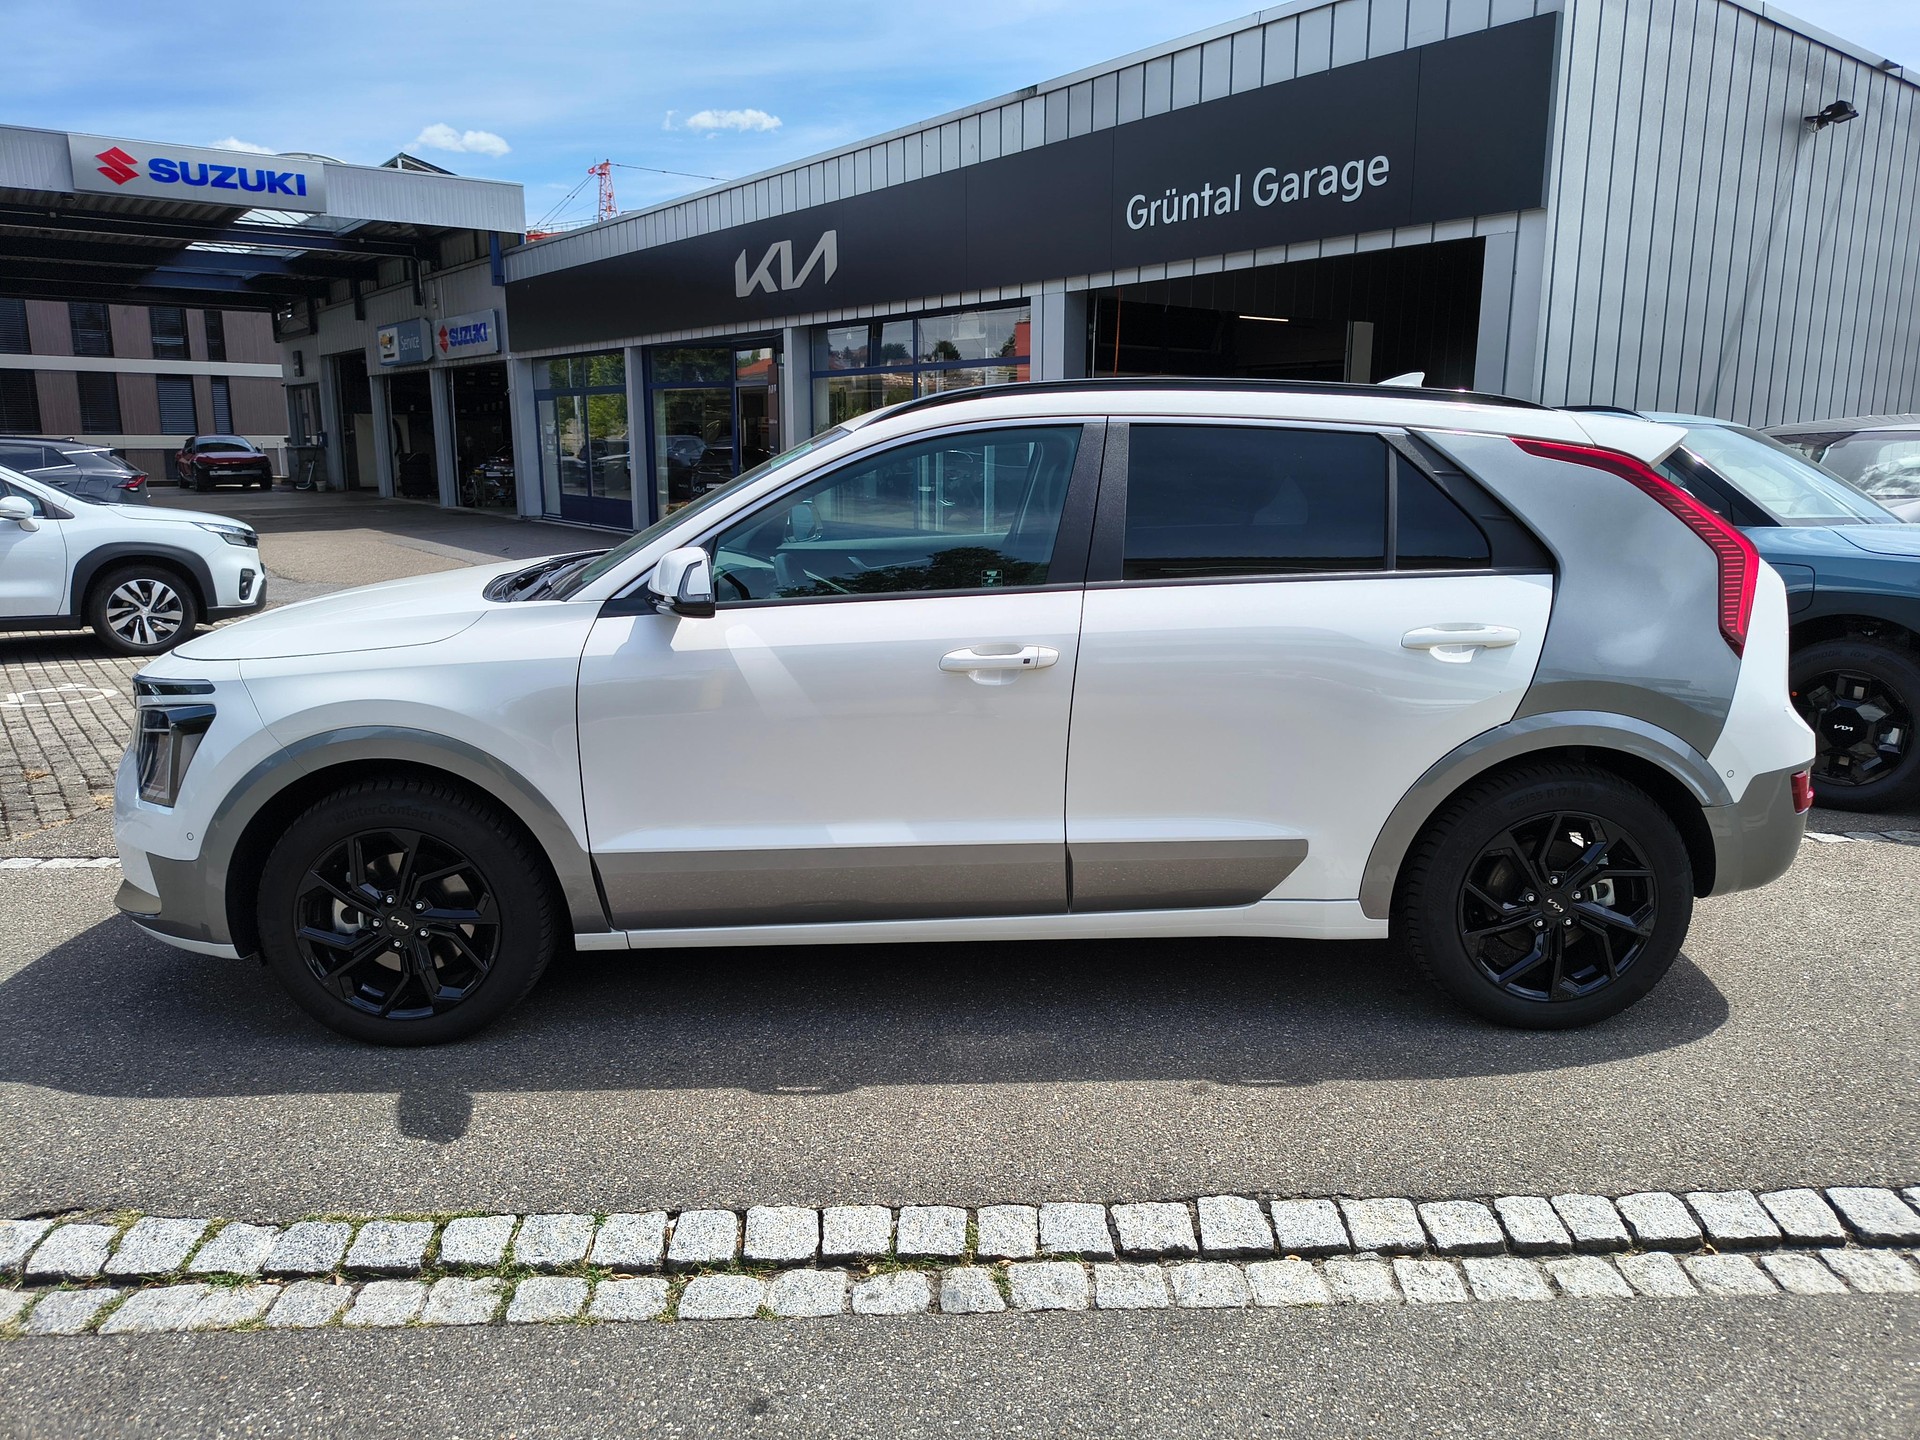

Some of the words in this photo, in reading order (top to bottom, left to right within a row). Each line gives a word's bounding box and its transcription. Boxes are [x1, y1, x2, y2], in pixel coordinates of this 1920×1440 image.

[148, 158, 307, 197] SUZUKI
[1126, 173, 1241, 230] Grüntal
[1252, 155, 1390, 203] Garage
[735, 229, 838, 298] KIA
[400, 334, 420, 351] Service
[449, 322, 488, 347] SUZUKI
